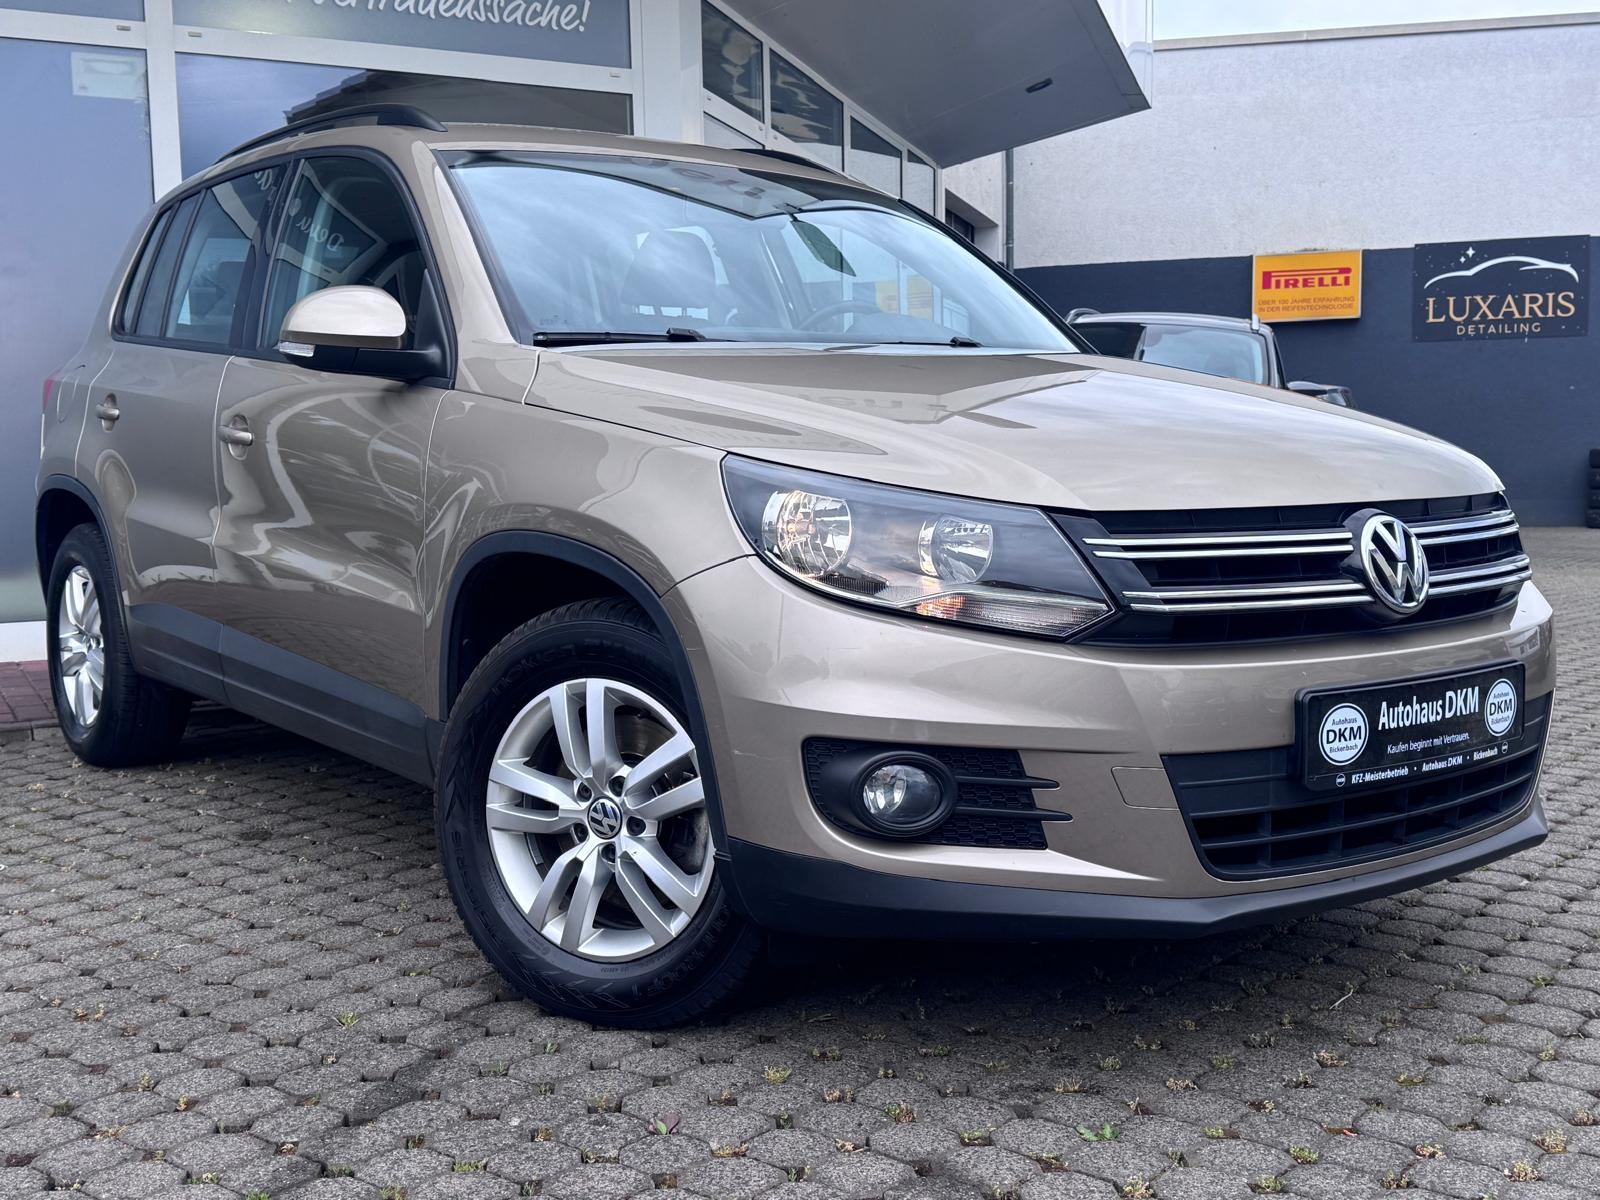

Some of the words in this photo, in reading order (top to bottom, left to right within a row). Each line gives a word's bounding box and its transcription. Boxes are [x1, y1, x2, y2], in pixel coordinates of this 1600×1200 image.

[313, 0, 591, 32] auenssache!
[1261, 267, 1352, 290] PIRELLI
[1313, 295, 1355, 304] ERFAHRUNG
[1425, 291, 1576, 323] LUXARIS
[1456, 322, 1542, 336] DETAILING
[1378, 695, 1443, 731] Autohaus
[1445, 686, 1479, 719] DKM
[1489, 698, 1513, 717] DKM
[1331, 716, 1358, 727] Autohaus
[1326, 725, 1362, 745] DKM
[1387, 742, 1409, 755] Kaufen
[1409, 738, 1433, 752] beginnt
[1433, 735, 1443, 746] mit
[1329, 742, 1359, 754] Bickenbach
[1351, 765, 1409, 784] KFZ-Meisterbetrieb
[1422, 760, 1448, 773] Autohaus
[1447, 755, 1463, 767] DKM
[1473, 746, 1498, 760] Bickenbach
